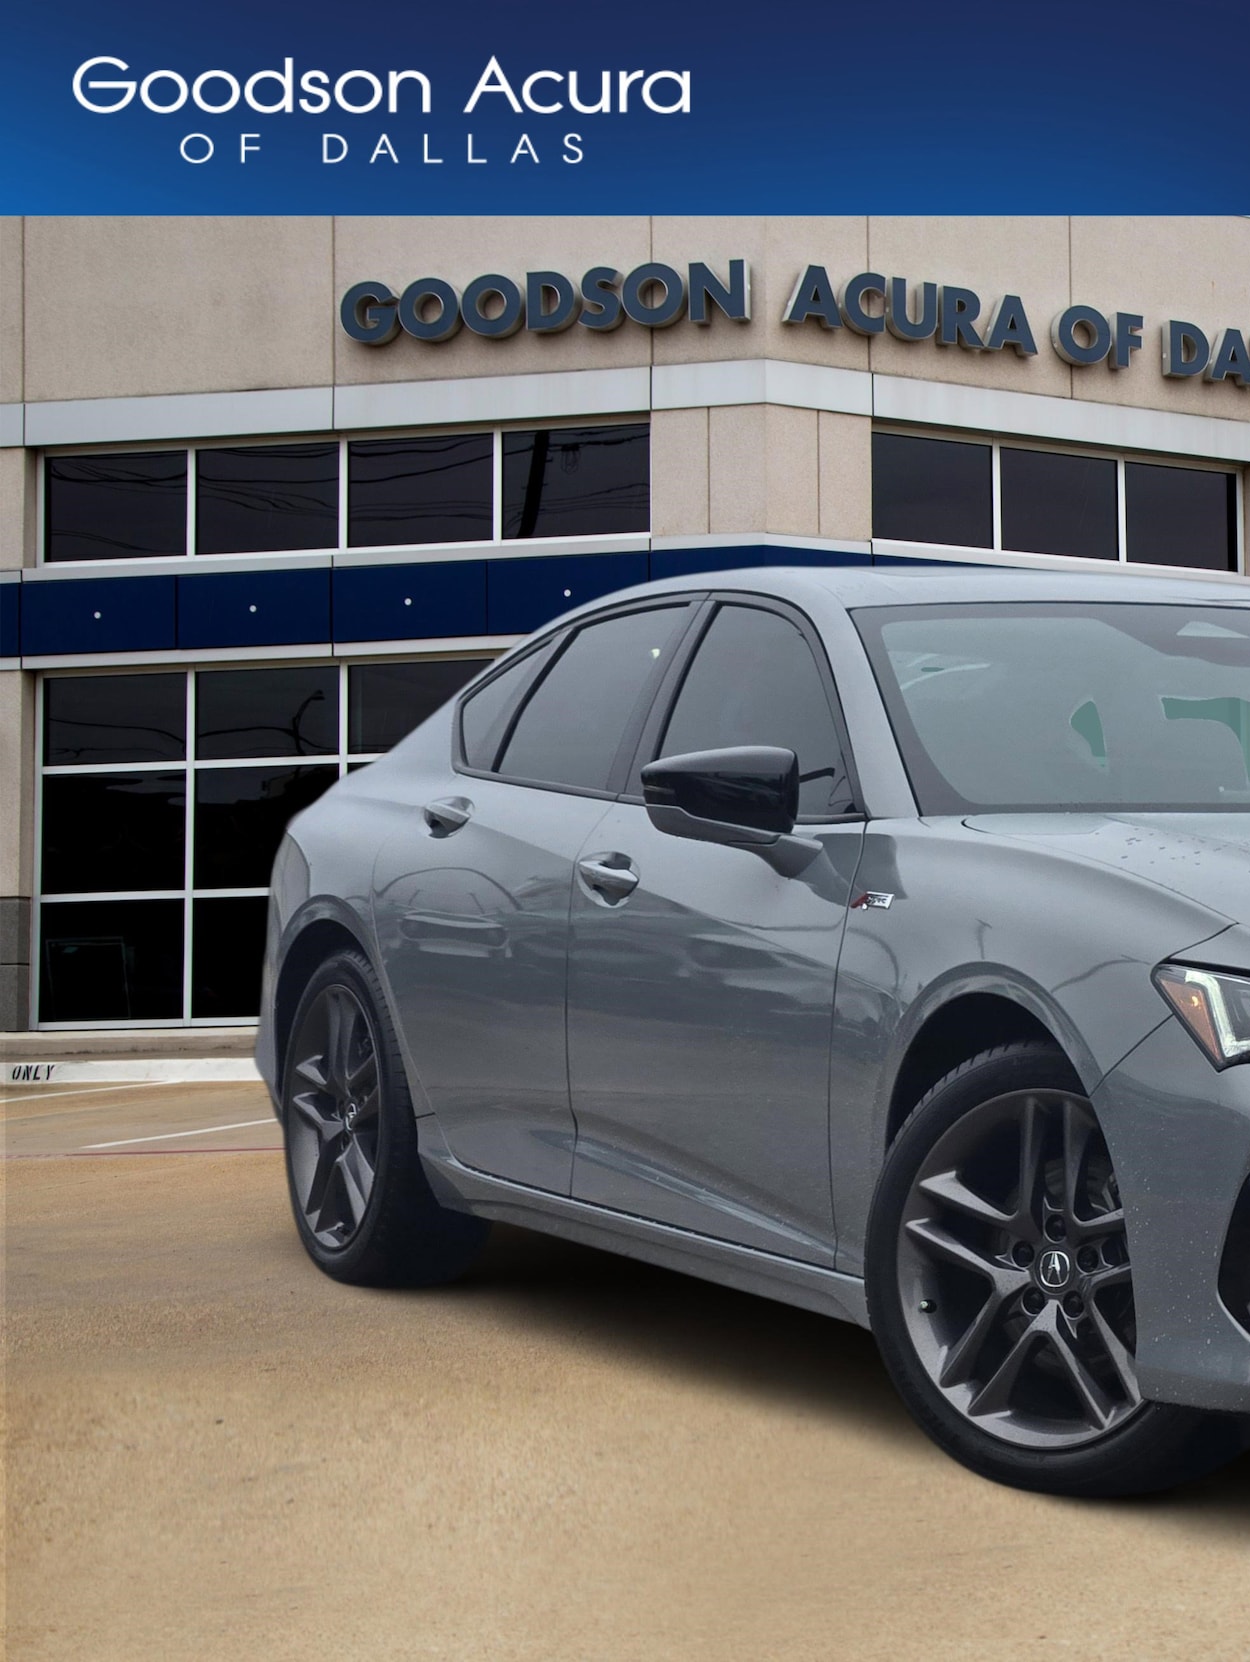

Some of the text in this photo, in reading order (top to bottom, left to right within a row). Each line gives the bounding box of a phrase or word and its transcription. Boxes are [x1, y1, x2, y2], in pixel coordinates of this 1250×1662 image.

[340, 258, 751, 346] GOODSON
[782, 264, 1038, 357] ACURA
[1051, 305, 1144, 369] OF
[12, 1064, 55, 1081] ONLY
